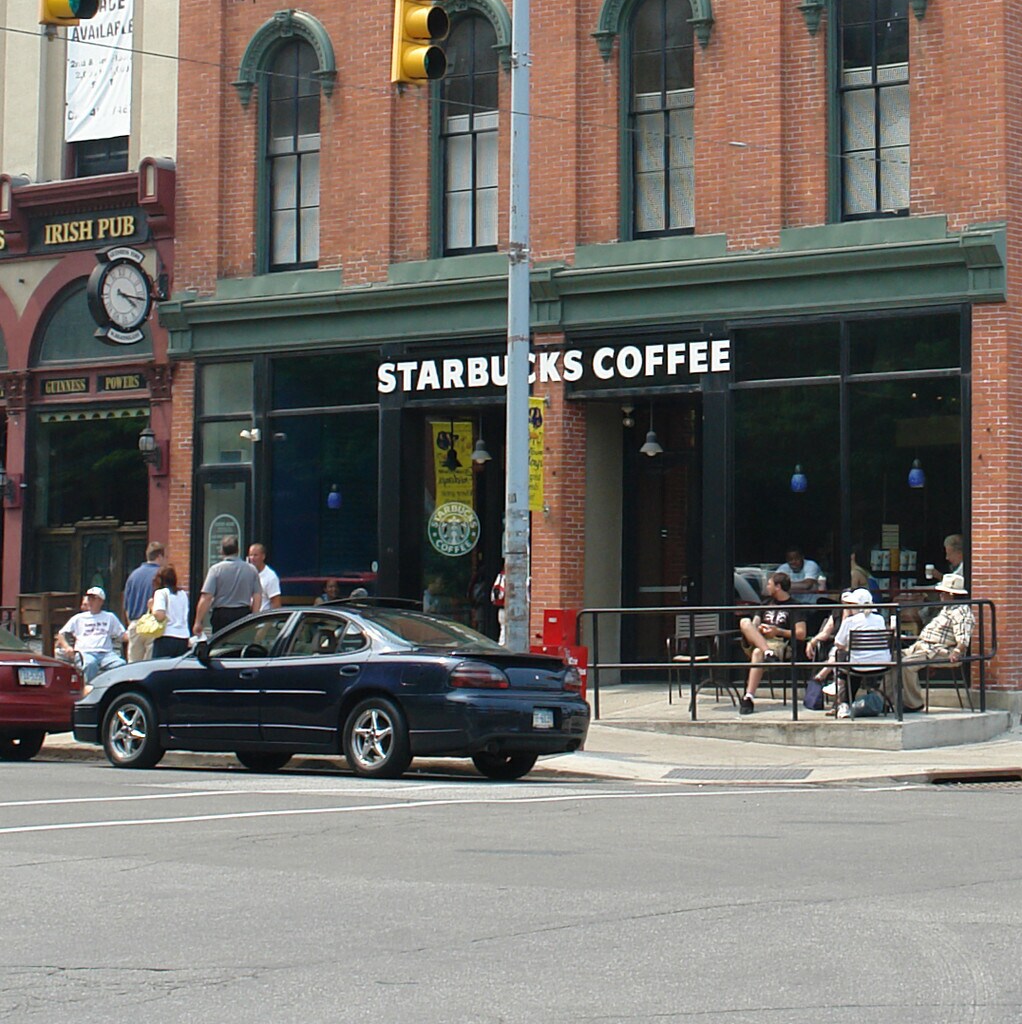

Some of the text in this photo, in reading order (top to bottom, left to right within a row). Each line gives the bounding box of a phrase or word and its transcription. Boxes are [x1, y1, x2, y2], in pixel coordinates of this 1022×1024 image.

[45, 215, 135, 245] IRISH PUB
[592, 339, 731, 381] COFFEE
[45, 374, 140, 394] GUINNESS POWERS
[431, 504, 478, 528] STARBUCKS
[435, 539, 472, 554] COFFEE
